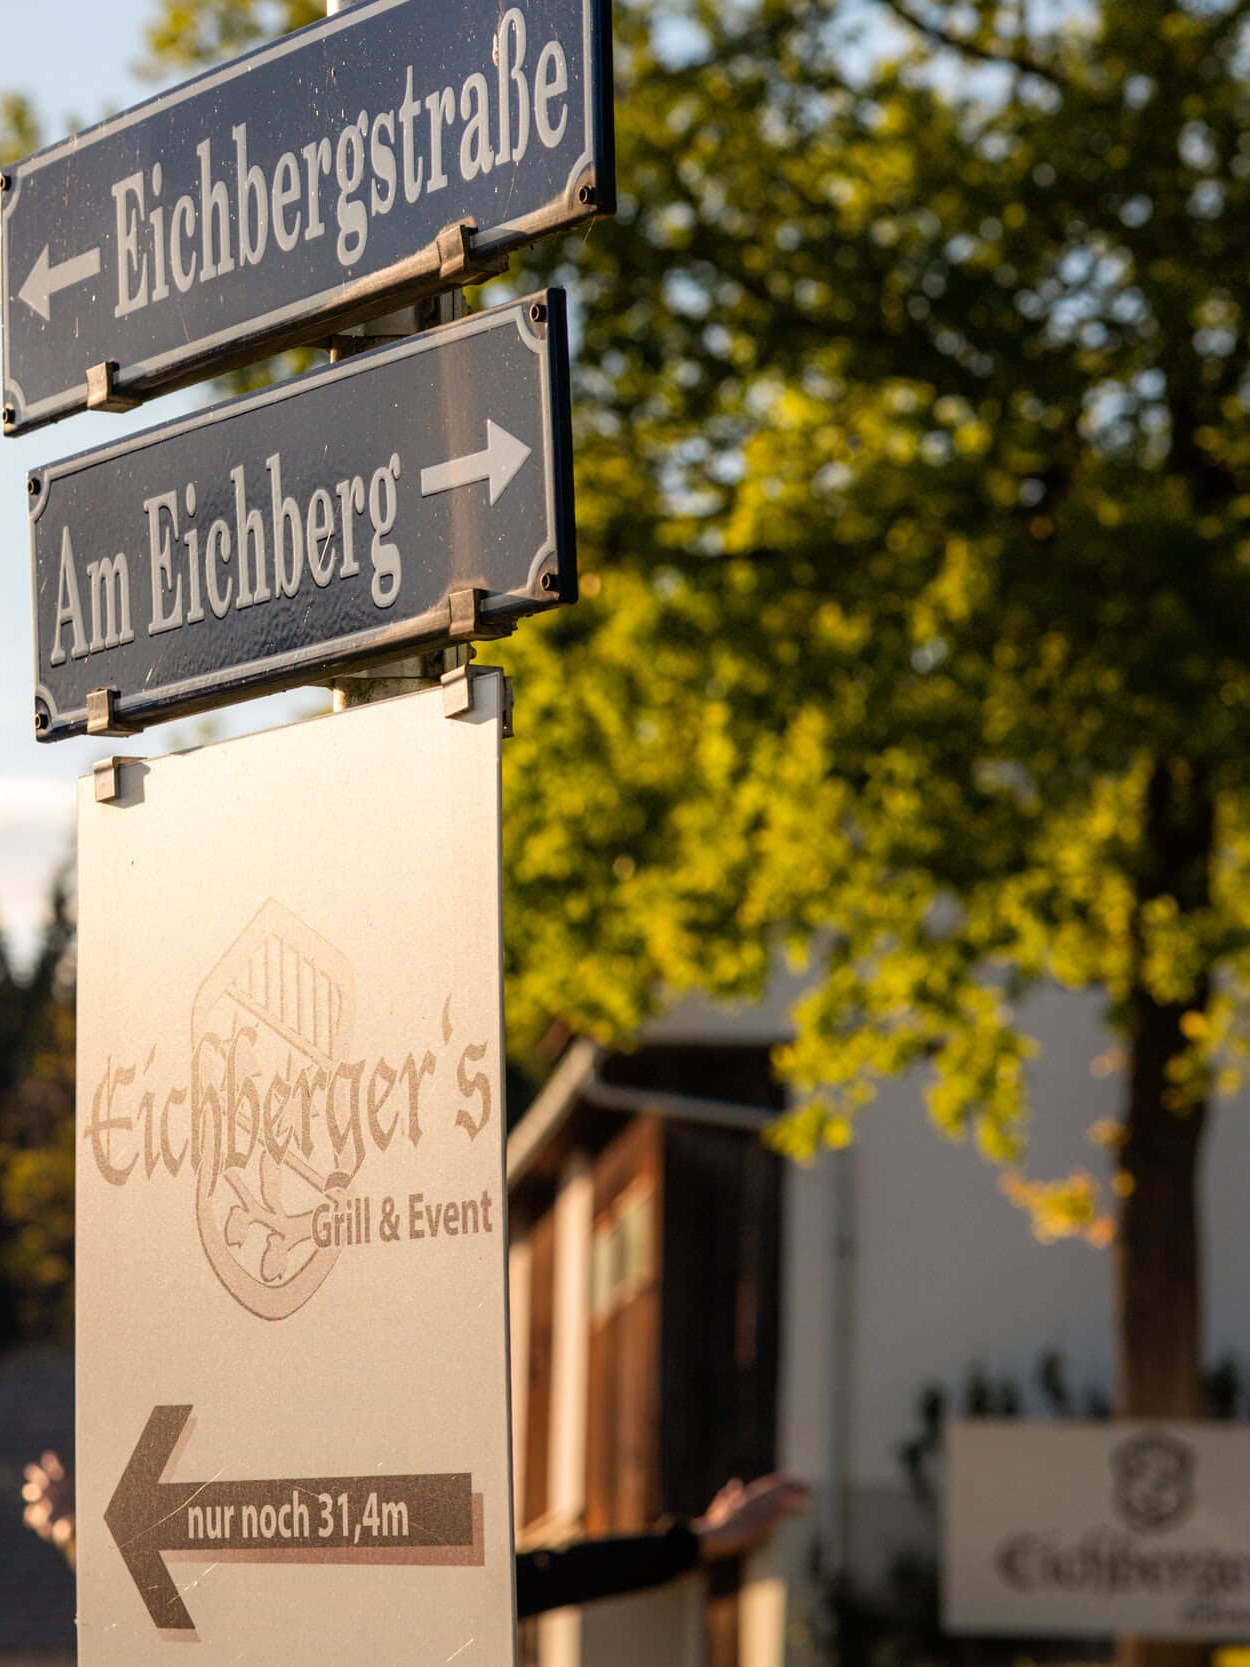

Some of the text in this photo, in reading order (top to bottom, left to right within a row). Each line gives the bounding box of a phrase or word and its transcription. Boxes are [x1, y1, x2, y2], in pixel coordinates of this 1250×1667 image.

[111, 7, 568, 318] Eichbergstraße
[51, 452, 402, 667] Am Eichberg
[311, 1190, 493, 1248] Grill & Event
[188, 1491, 409, 1544] nur noch 31,4m
